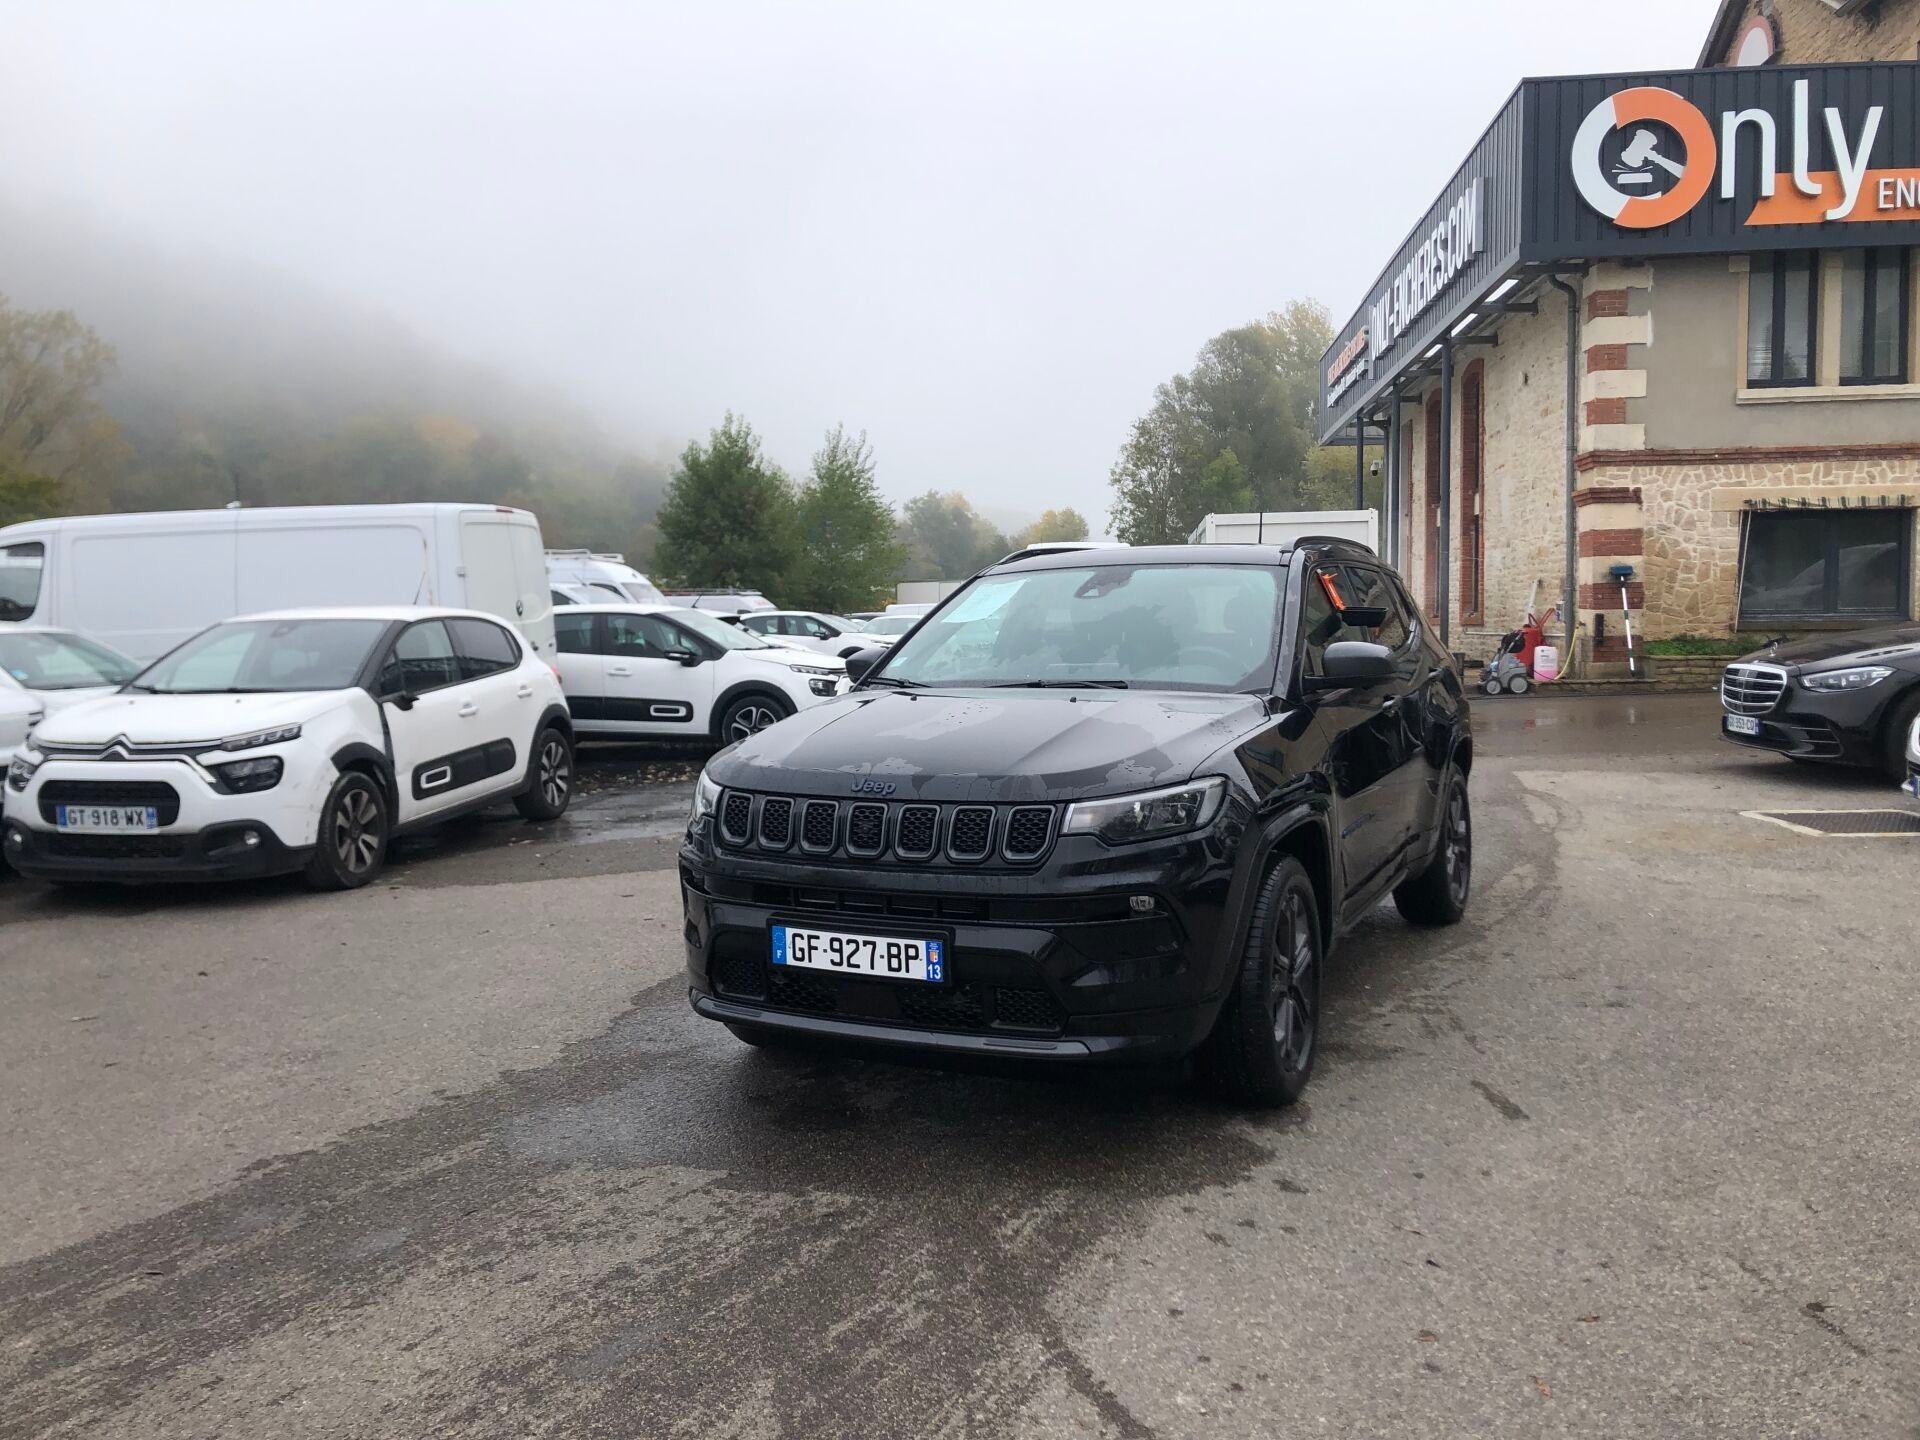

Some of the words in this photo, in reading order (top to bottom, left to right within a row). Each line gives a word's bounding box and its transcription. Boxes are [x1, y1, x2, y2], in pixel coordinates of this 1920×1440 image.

[1571, 79, 1884, 228] Only
[1878, 177, 1920, 209] EN
[850, 776, 897, 796] Jeep
[776, 949, 783, 959] F
[791, 932, 920, 974] GF-927-BP
[927, 963, 942, 980] 13
